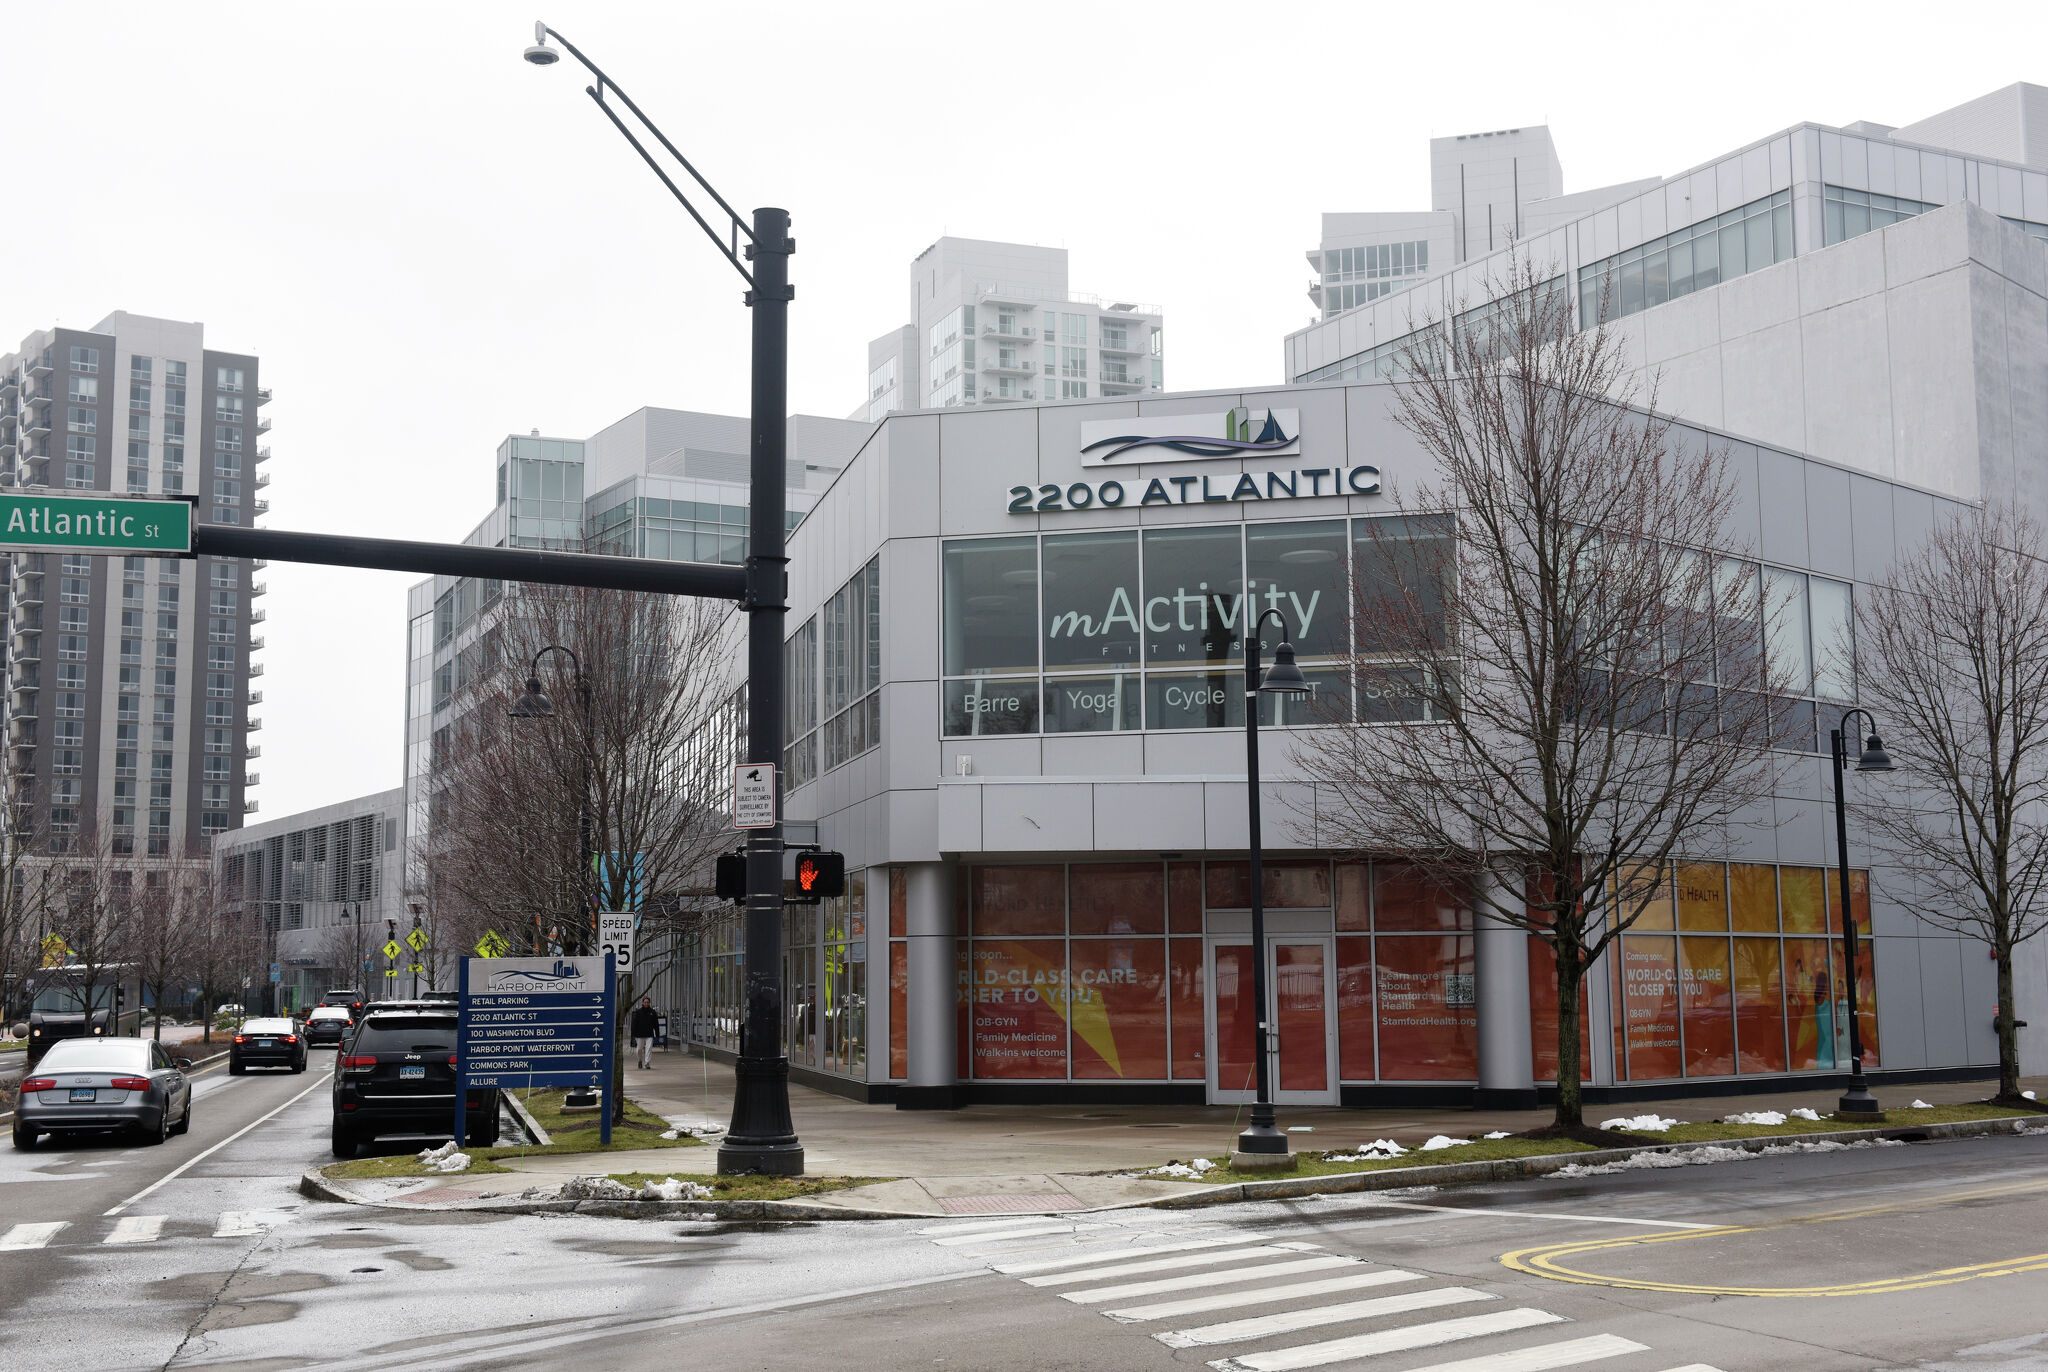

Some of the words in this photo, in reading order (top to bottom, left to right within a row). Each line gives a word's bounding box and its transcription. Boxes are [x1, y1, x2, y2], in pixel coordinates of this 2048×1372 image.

[1008, 480, 1124, 513] 2200
[1141, 465, 1380, 505] ATLANTIC
[7, 507, 134, 537] Atlantic
[144, 524, 159, 538] St
[1049, 581, 1321, 639] mActivity
[1102, 640, 1268, 656] FITNESS
[1067, 690, 1118, 713] Yoga
[1165, 685, 1225, 711] Cycle
[964, 694, 1020, 713] Barre
[1687, 886, 1719, 901] HEALTH
[602, 919, 632, 929] SPEED
[604, 932, 628, 941] LIMIT
[1626, 952, 1649, 962] Coming
[957, 969, 1074, 985] RLD-CLASS
[1080, 968, 1138, 984] CARE
[1380, 972, 1411, 981] Learn
[1412, 973, 1439, 981] more
[1696, 968, 1722, 980] CARE
[487, 982, 545, 992] HARBOR
[546, 981, 586, 991] POINT
[1381, 982, 1411, 990] about
[1628, 983, 1665, 996] CLOSER
[1684, 983, 1703, 995] YOU
[1011, 987, 1040, 1003] TO
[1046, 987, 1092, 1003] YOU
[1381, 991, 1429, 1001] Stamford
[497, 997, 530, 1005] PARKING
[1381, 1001, 1416, 1011] Health
[471, 1014, 491, 1022] 2200
[492, 1013, 526, 1021] ATLANTIC
[528, 1012, 538, 1020] ST
[1630, 1008, 1652, 1018] OB-GYN
[975, 1017, 1019, 1027] OB-GYN
[1382, 1017, 1477, 1027] StamfordHealth.org
[471, 1030, 484, 1038] 100
[486, 1029, 535, 1037] WASHINGTON
[536, 1028, 555, 1036] BLVD
[1630, 1024, 1647, 1034] Family
[1647, 1024, 1675, 1032] Medicine
[976, 1032, 1009, 1044] Family
[1011, 1032, 1058, 1042] Medicine
[470, 1045, 501, 1054] HARBOR
[527, 1044, 576, 1052] WATERFRONT
[976, 1048, 1019, 1057] Walk-ins
[1021, 1047, 1066, 1057] welcome
[470, 1062, 508, 1070] COMMONS
[470, 1078, 498, 1086] ALLURE
